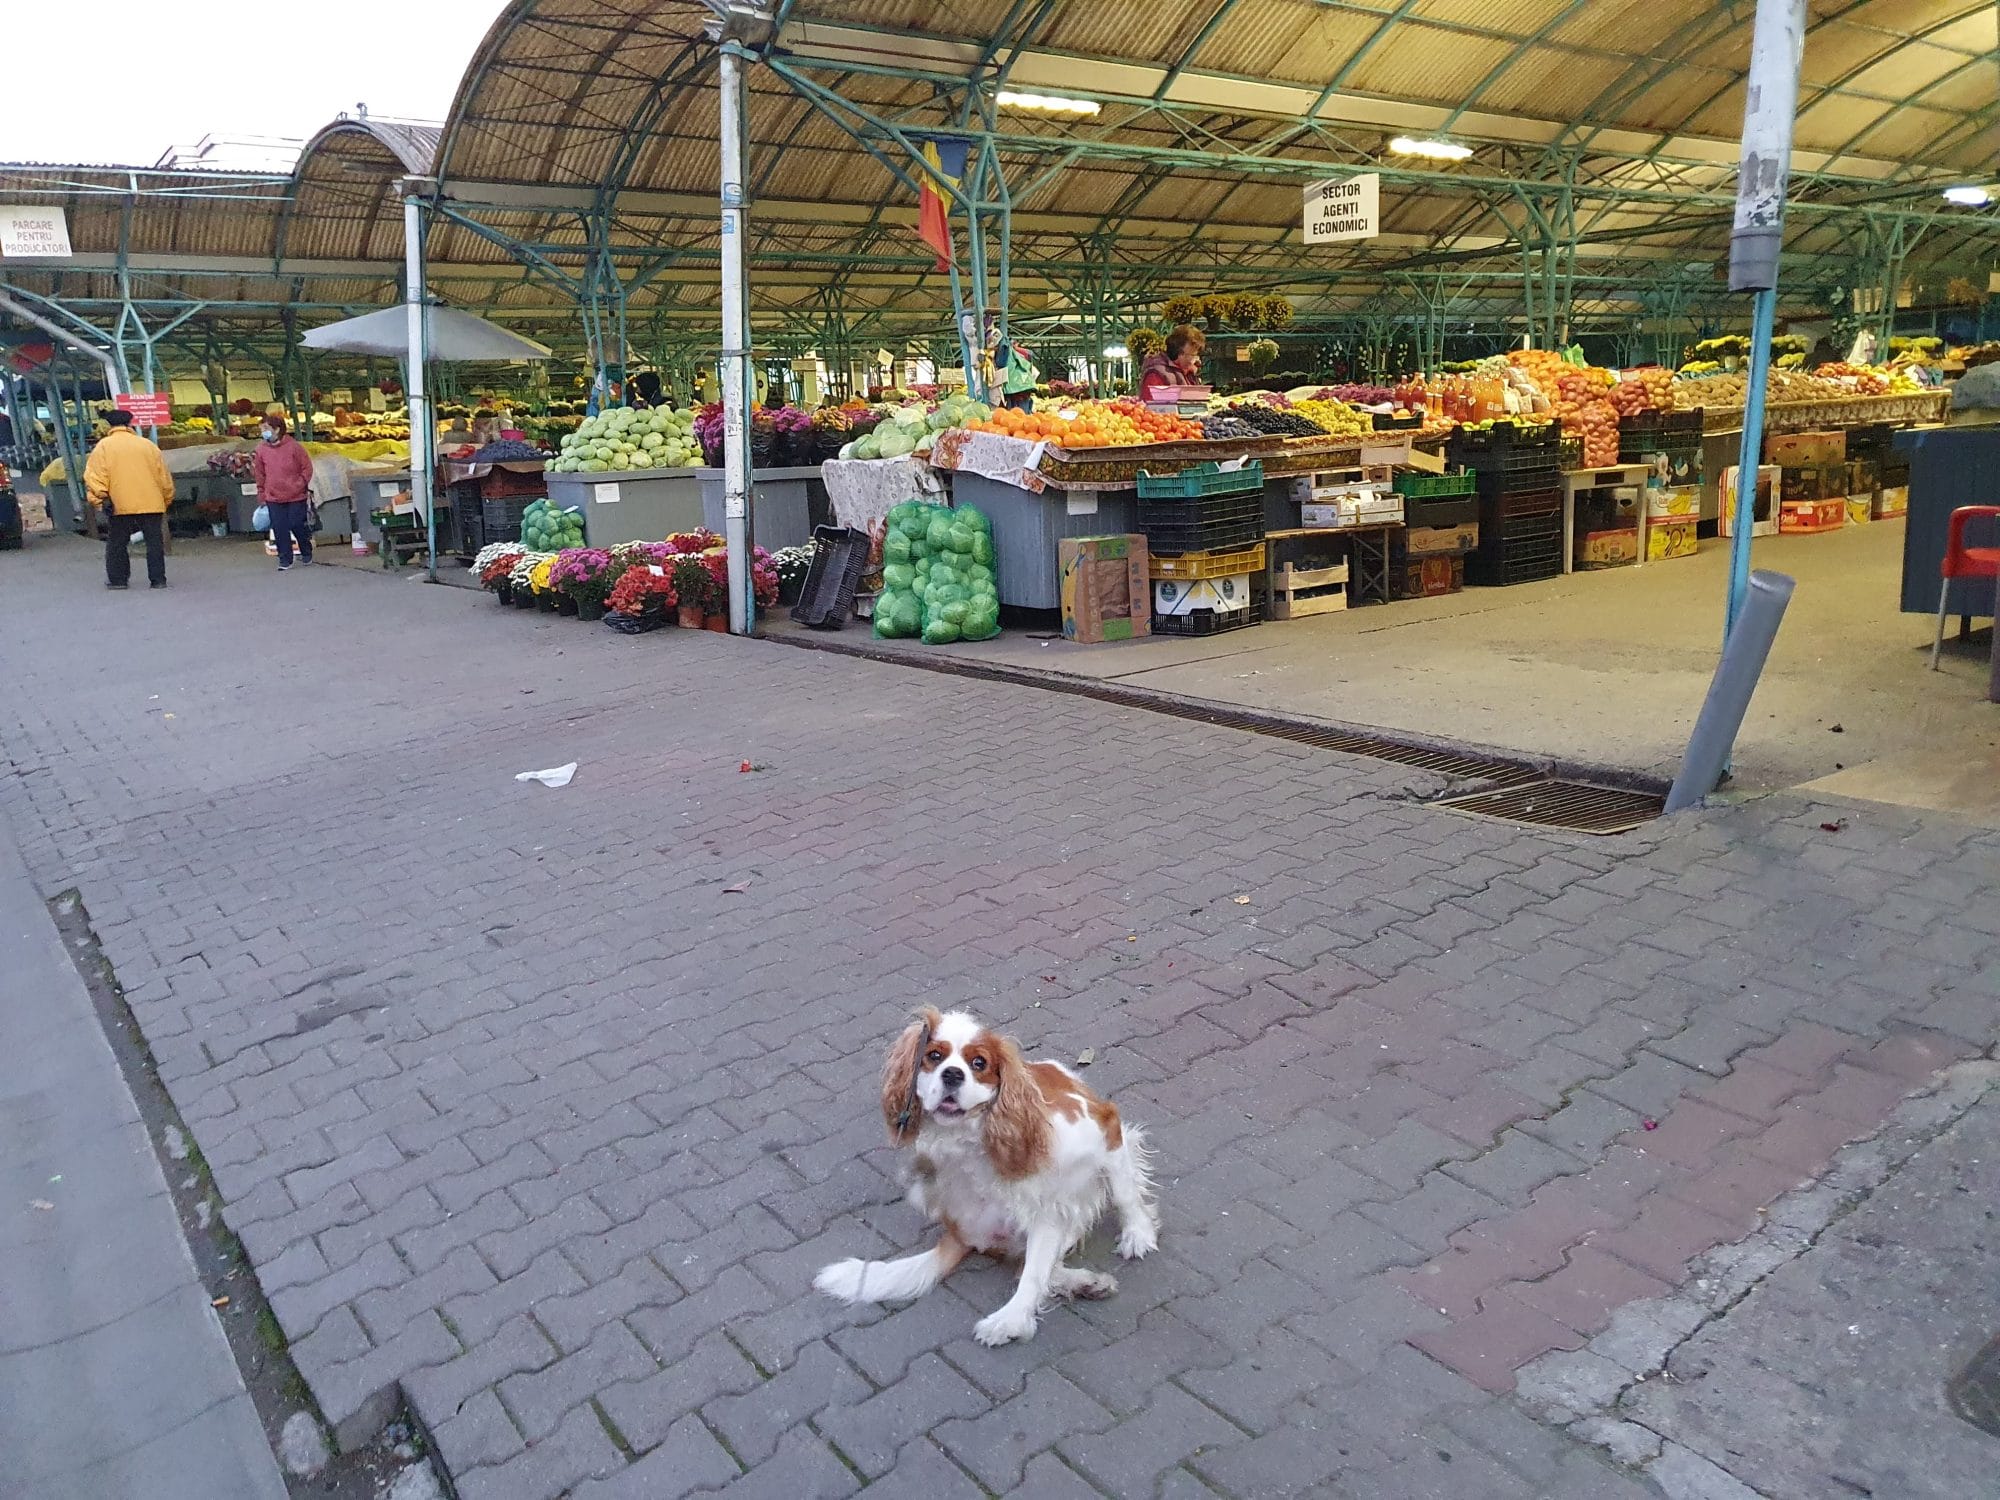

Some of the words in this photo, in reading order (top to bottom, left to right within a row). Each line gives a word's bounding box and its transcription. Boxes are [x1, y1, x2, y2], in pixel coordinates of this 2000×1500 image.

[1322, 184, 1361, 199] SECTOR
[12, 220, 54, 230] PARCARE
[1313, 218, 1368, 235] ECONOMICI
[16, 231, 52, 241] PENTRU
